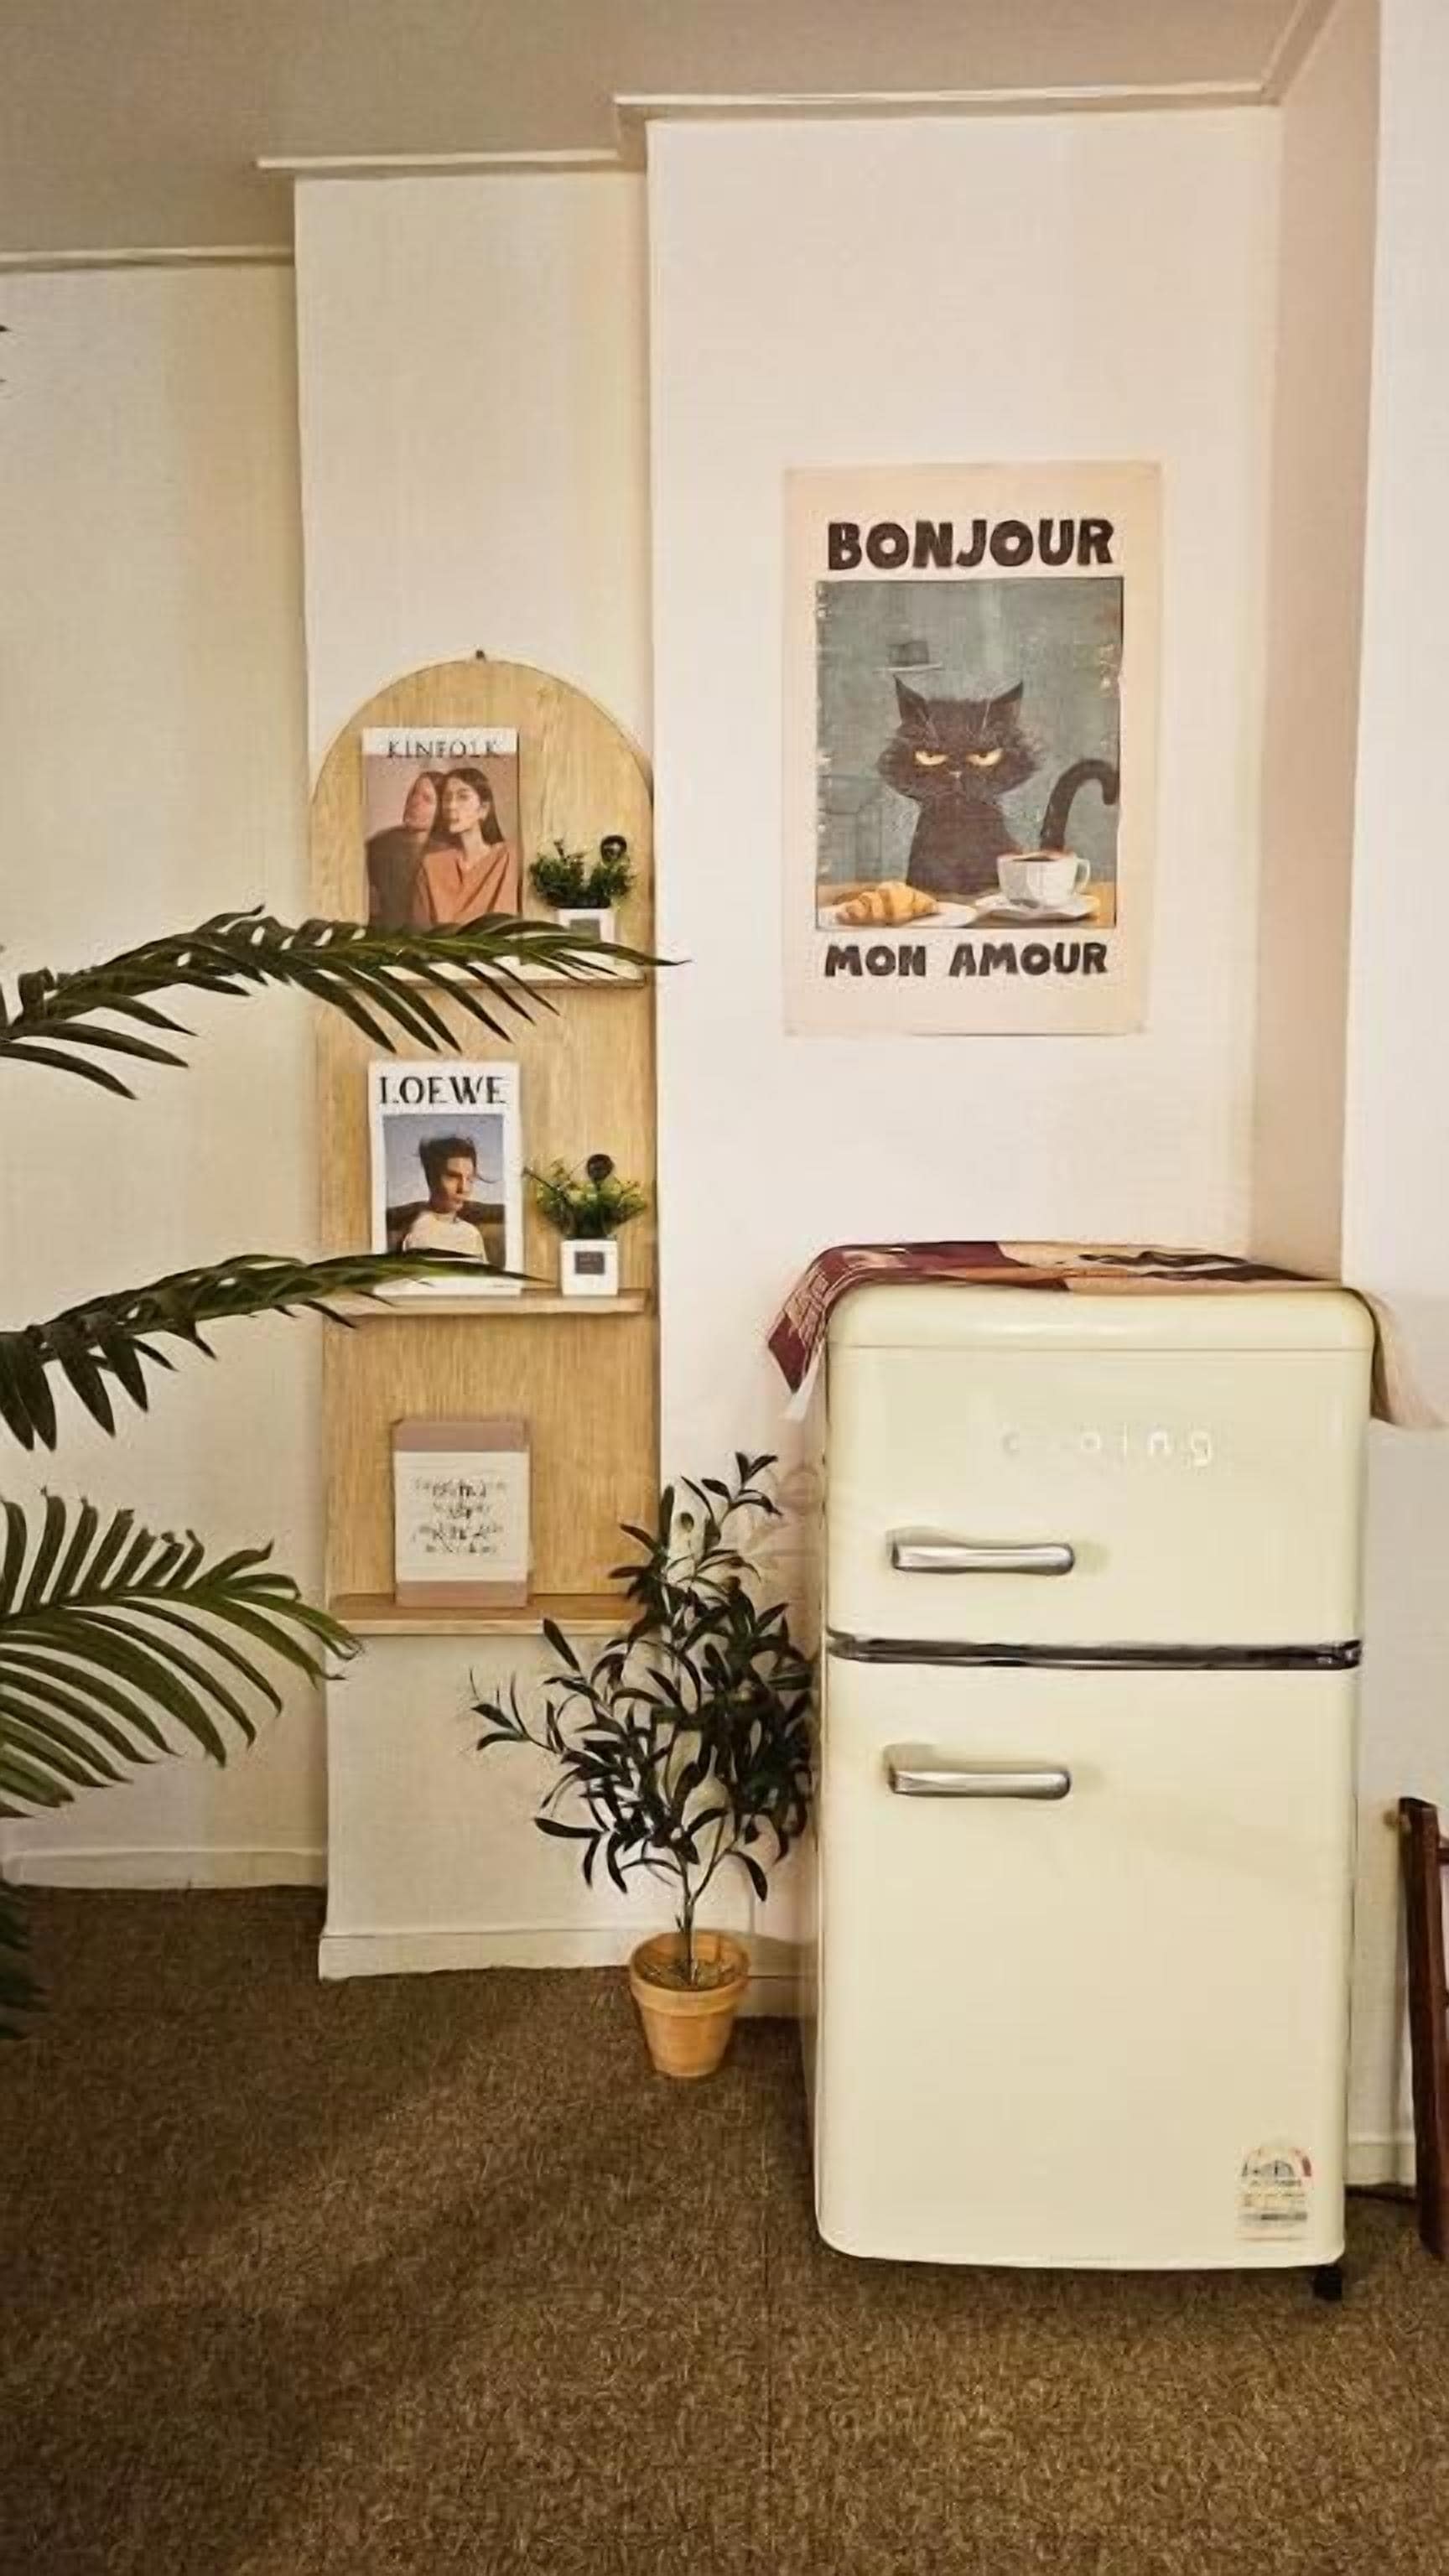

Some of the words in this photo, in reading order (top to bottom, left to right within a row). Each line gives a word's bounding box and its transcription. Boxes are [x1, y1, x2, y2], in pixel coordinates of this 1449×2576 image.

[828, 518, 1114, 570] BONJOUR
[387, 738, 501, 758] KINFOLK
[824, 945, 926, 977] MON
[948, 943, 1108, 977] AMOUR
[379, 1076, 506, 1104] LOEWE
